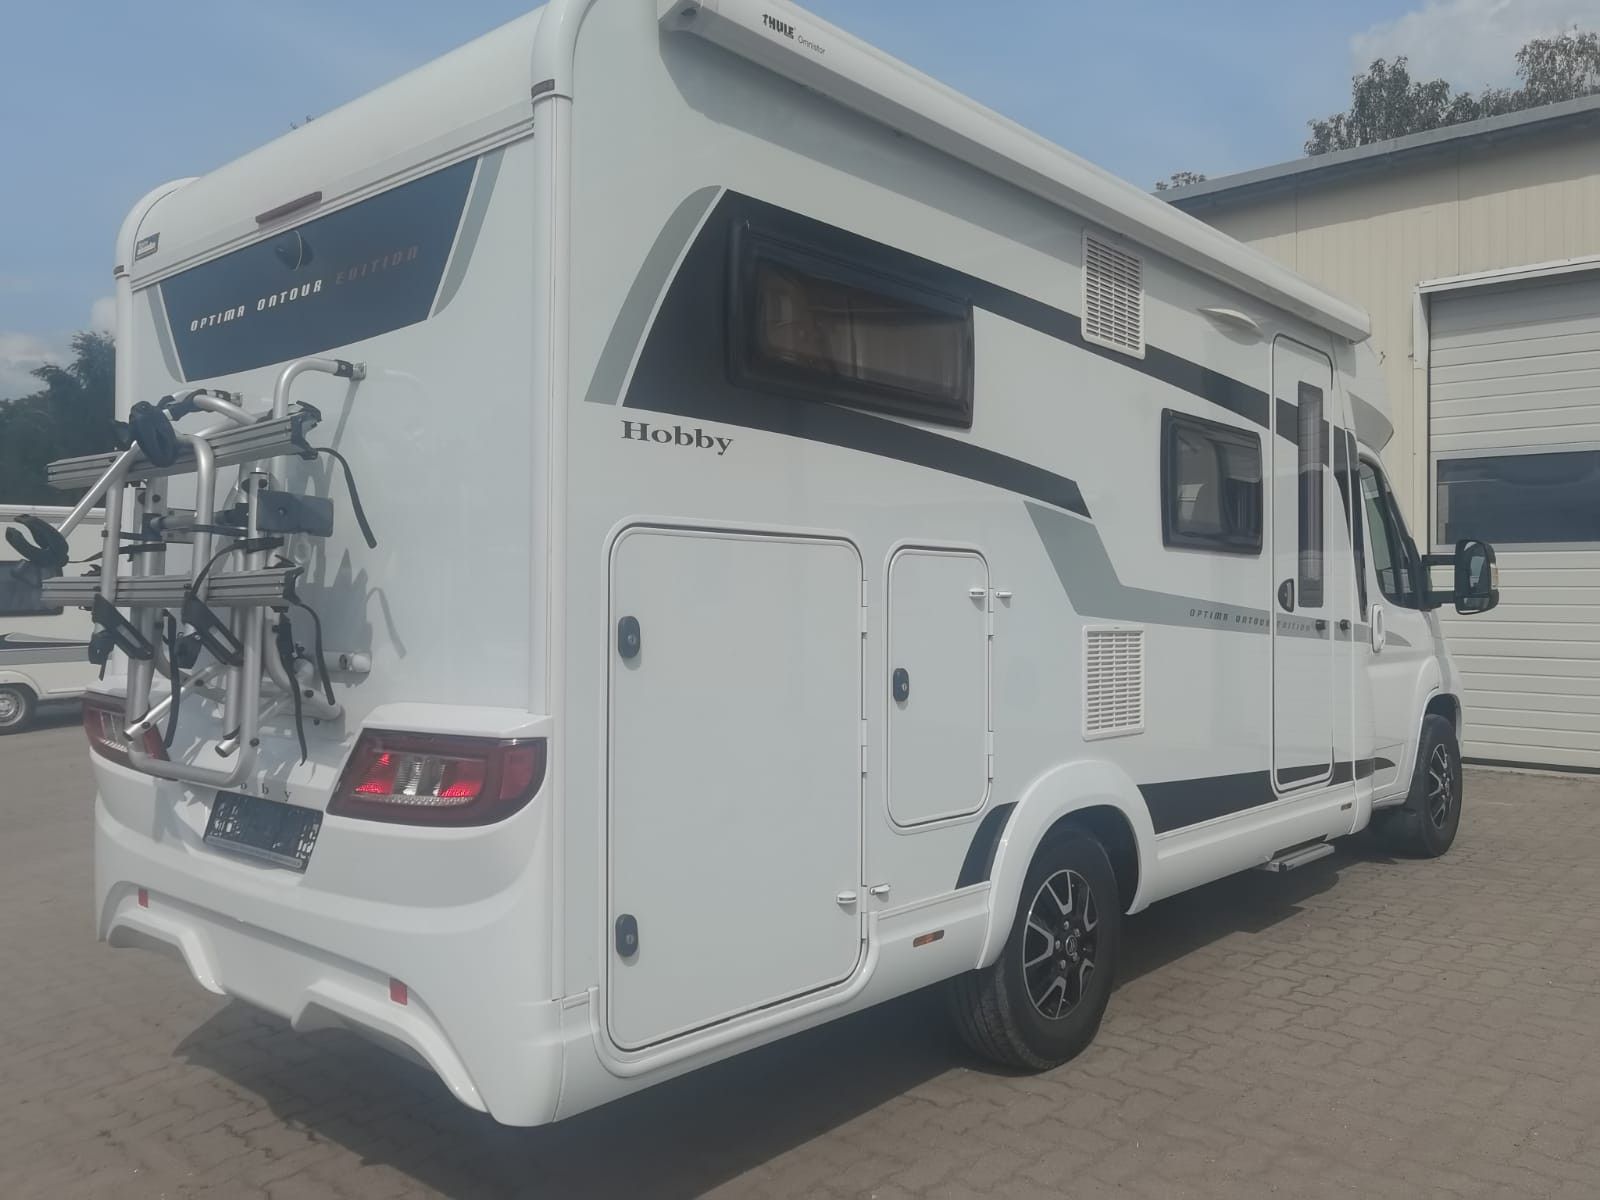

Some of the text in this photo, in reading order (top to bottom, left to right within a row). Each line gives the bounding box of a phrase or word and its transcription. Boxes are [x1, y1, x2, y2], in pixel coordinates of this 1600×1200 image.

[762, 14, 794, 39] THULE
[190, 246, 419, 331] OPTIMA ONTOUR EDITION
[621, 420, 734, 456] Hobby
[1189, 609, 1230, 621] OPTIMA
